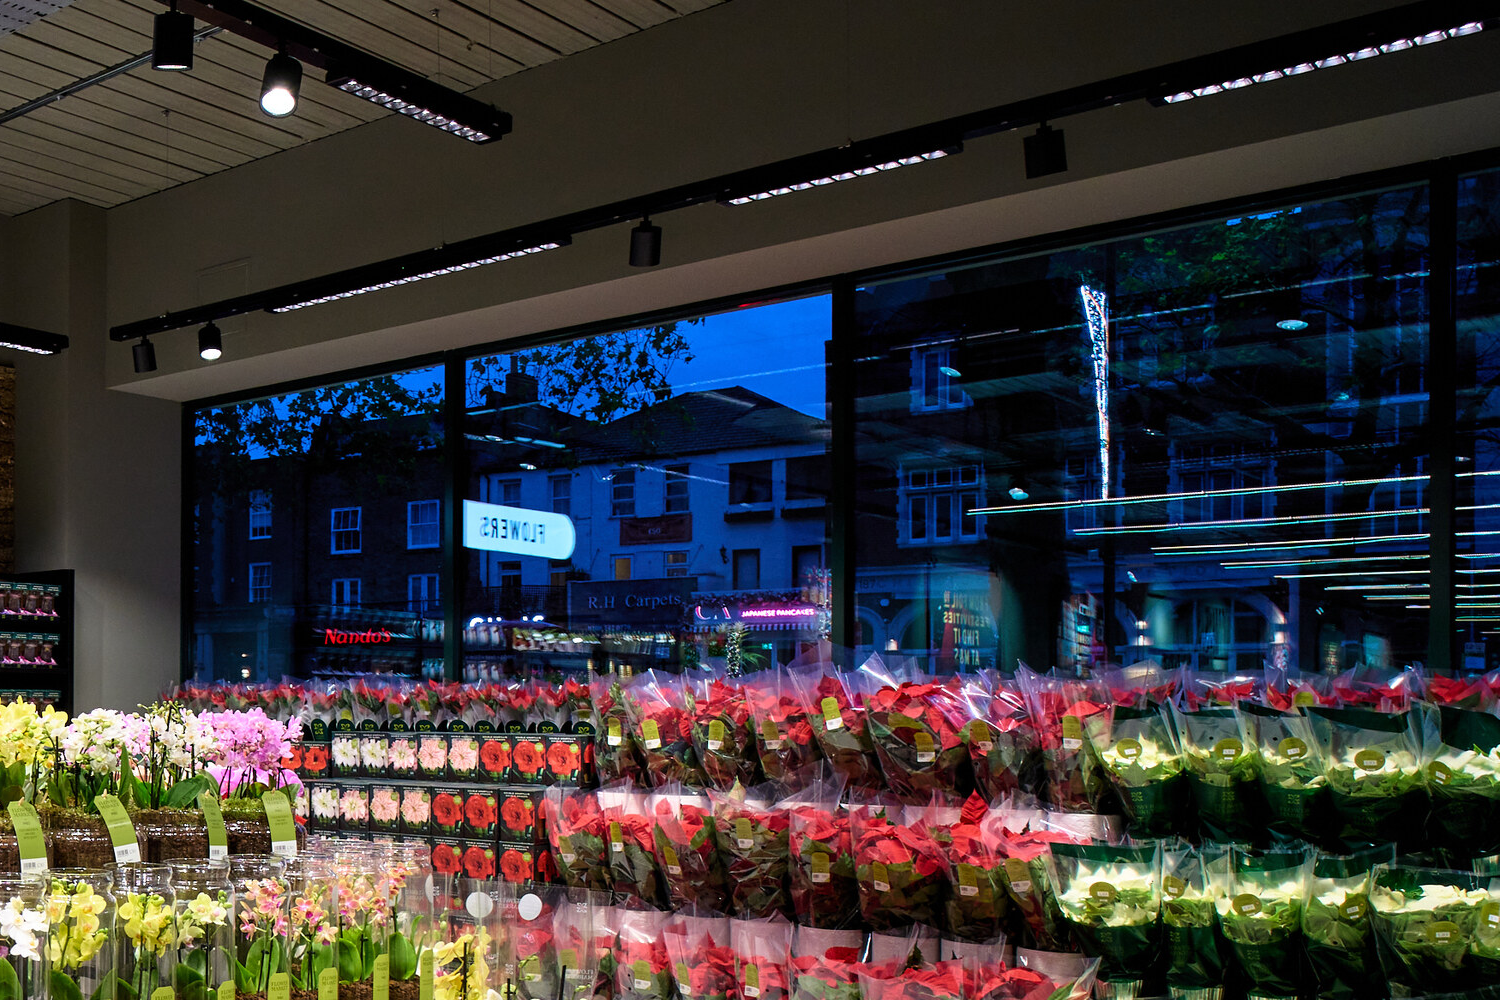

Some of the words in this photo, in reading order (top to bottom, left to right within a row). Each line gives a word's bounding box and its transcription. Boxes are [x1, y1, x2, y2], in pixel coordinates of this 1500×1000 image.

[625, 593, 681, 609] Carpets
[741, 608, 776, 617] JAPANESE
[776, 608, 814, 617] PANCAKES
[324, 627, 391, 645] Nando's
